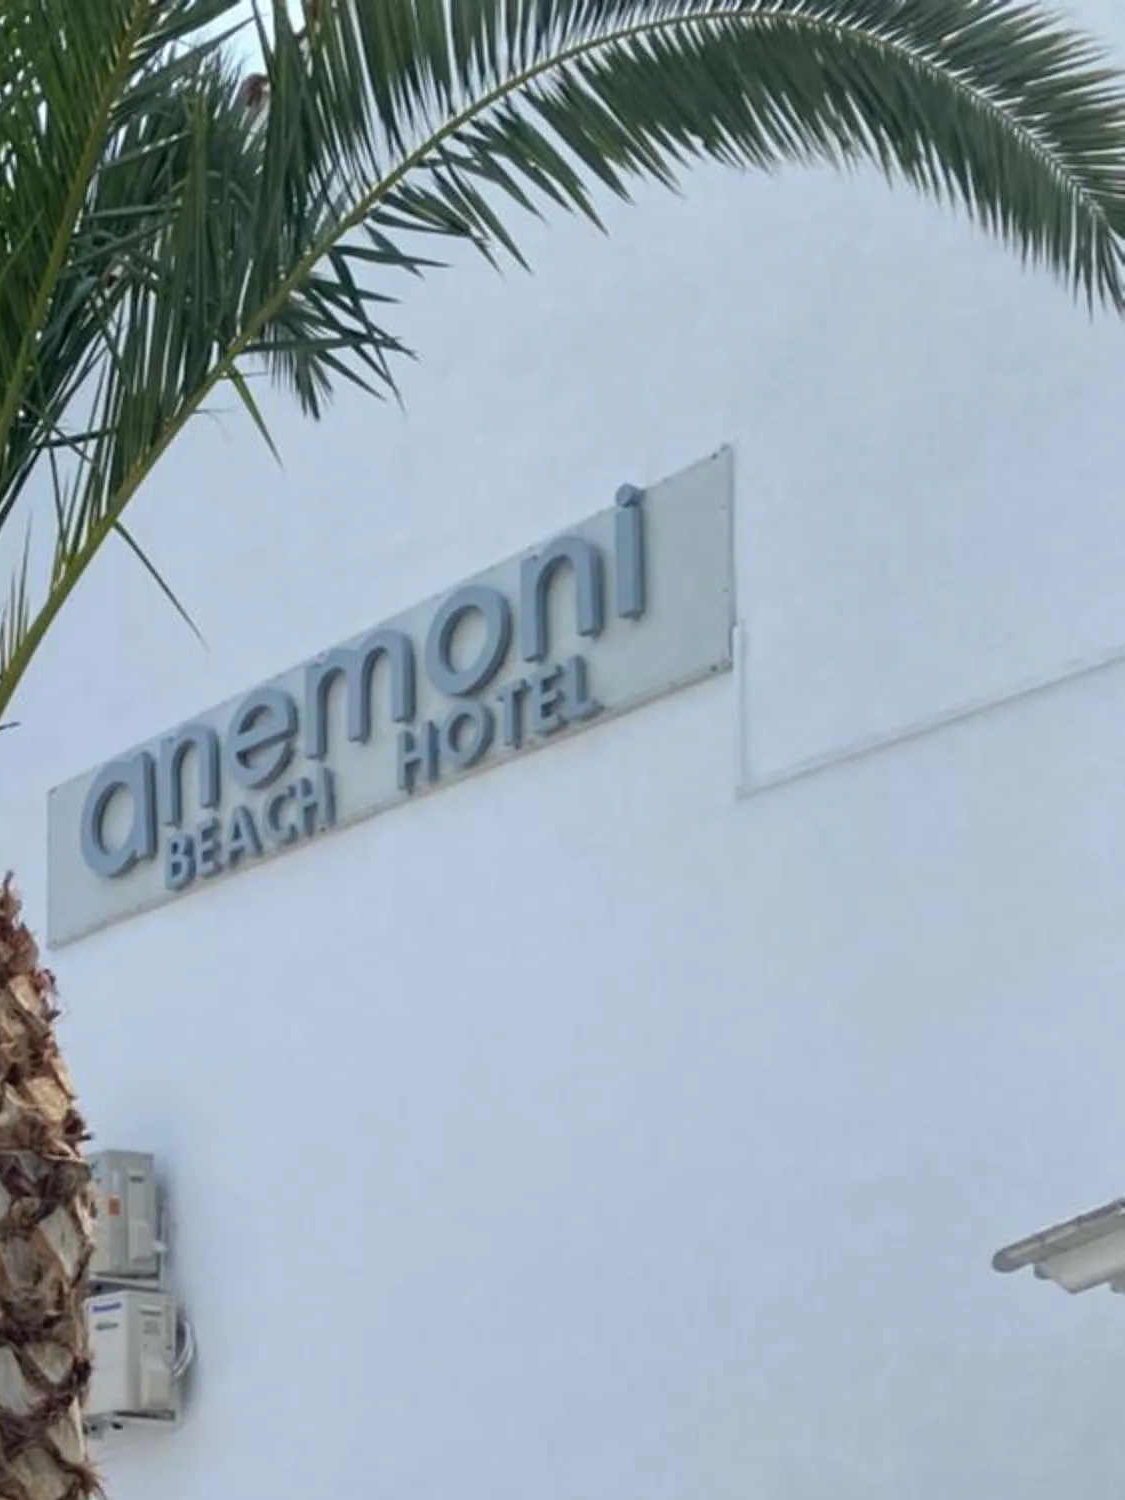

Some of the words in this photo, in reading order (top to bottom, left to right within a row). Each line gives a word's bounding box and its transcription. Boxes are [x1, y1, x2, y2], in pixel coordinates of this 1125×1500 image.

[81, 483, 646, 879] anemoni
[165, 767, 336, 891] BEACH
[397, 655, 605, 794] HOTEL
